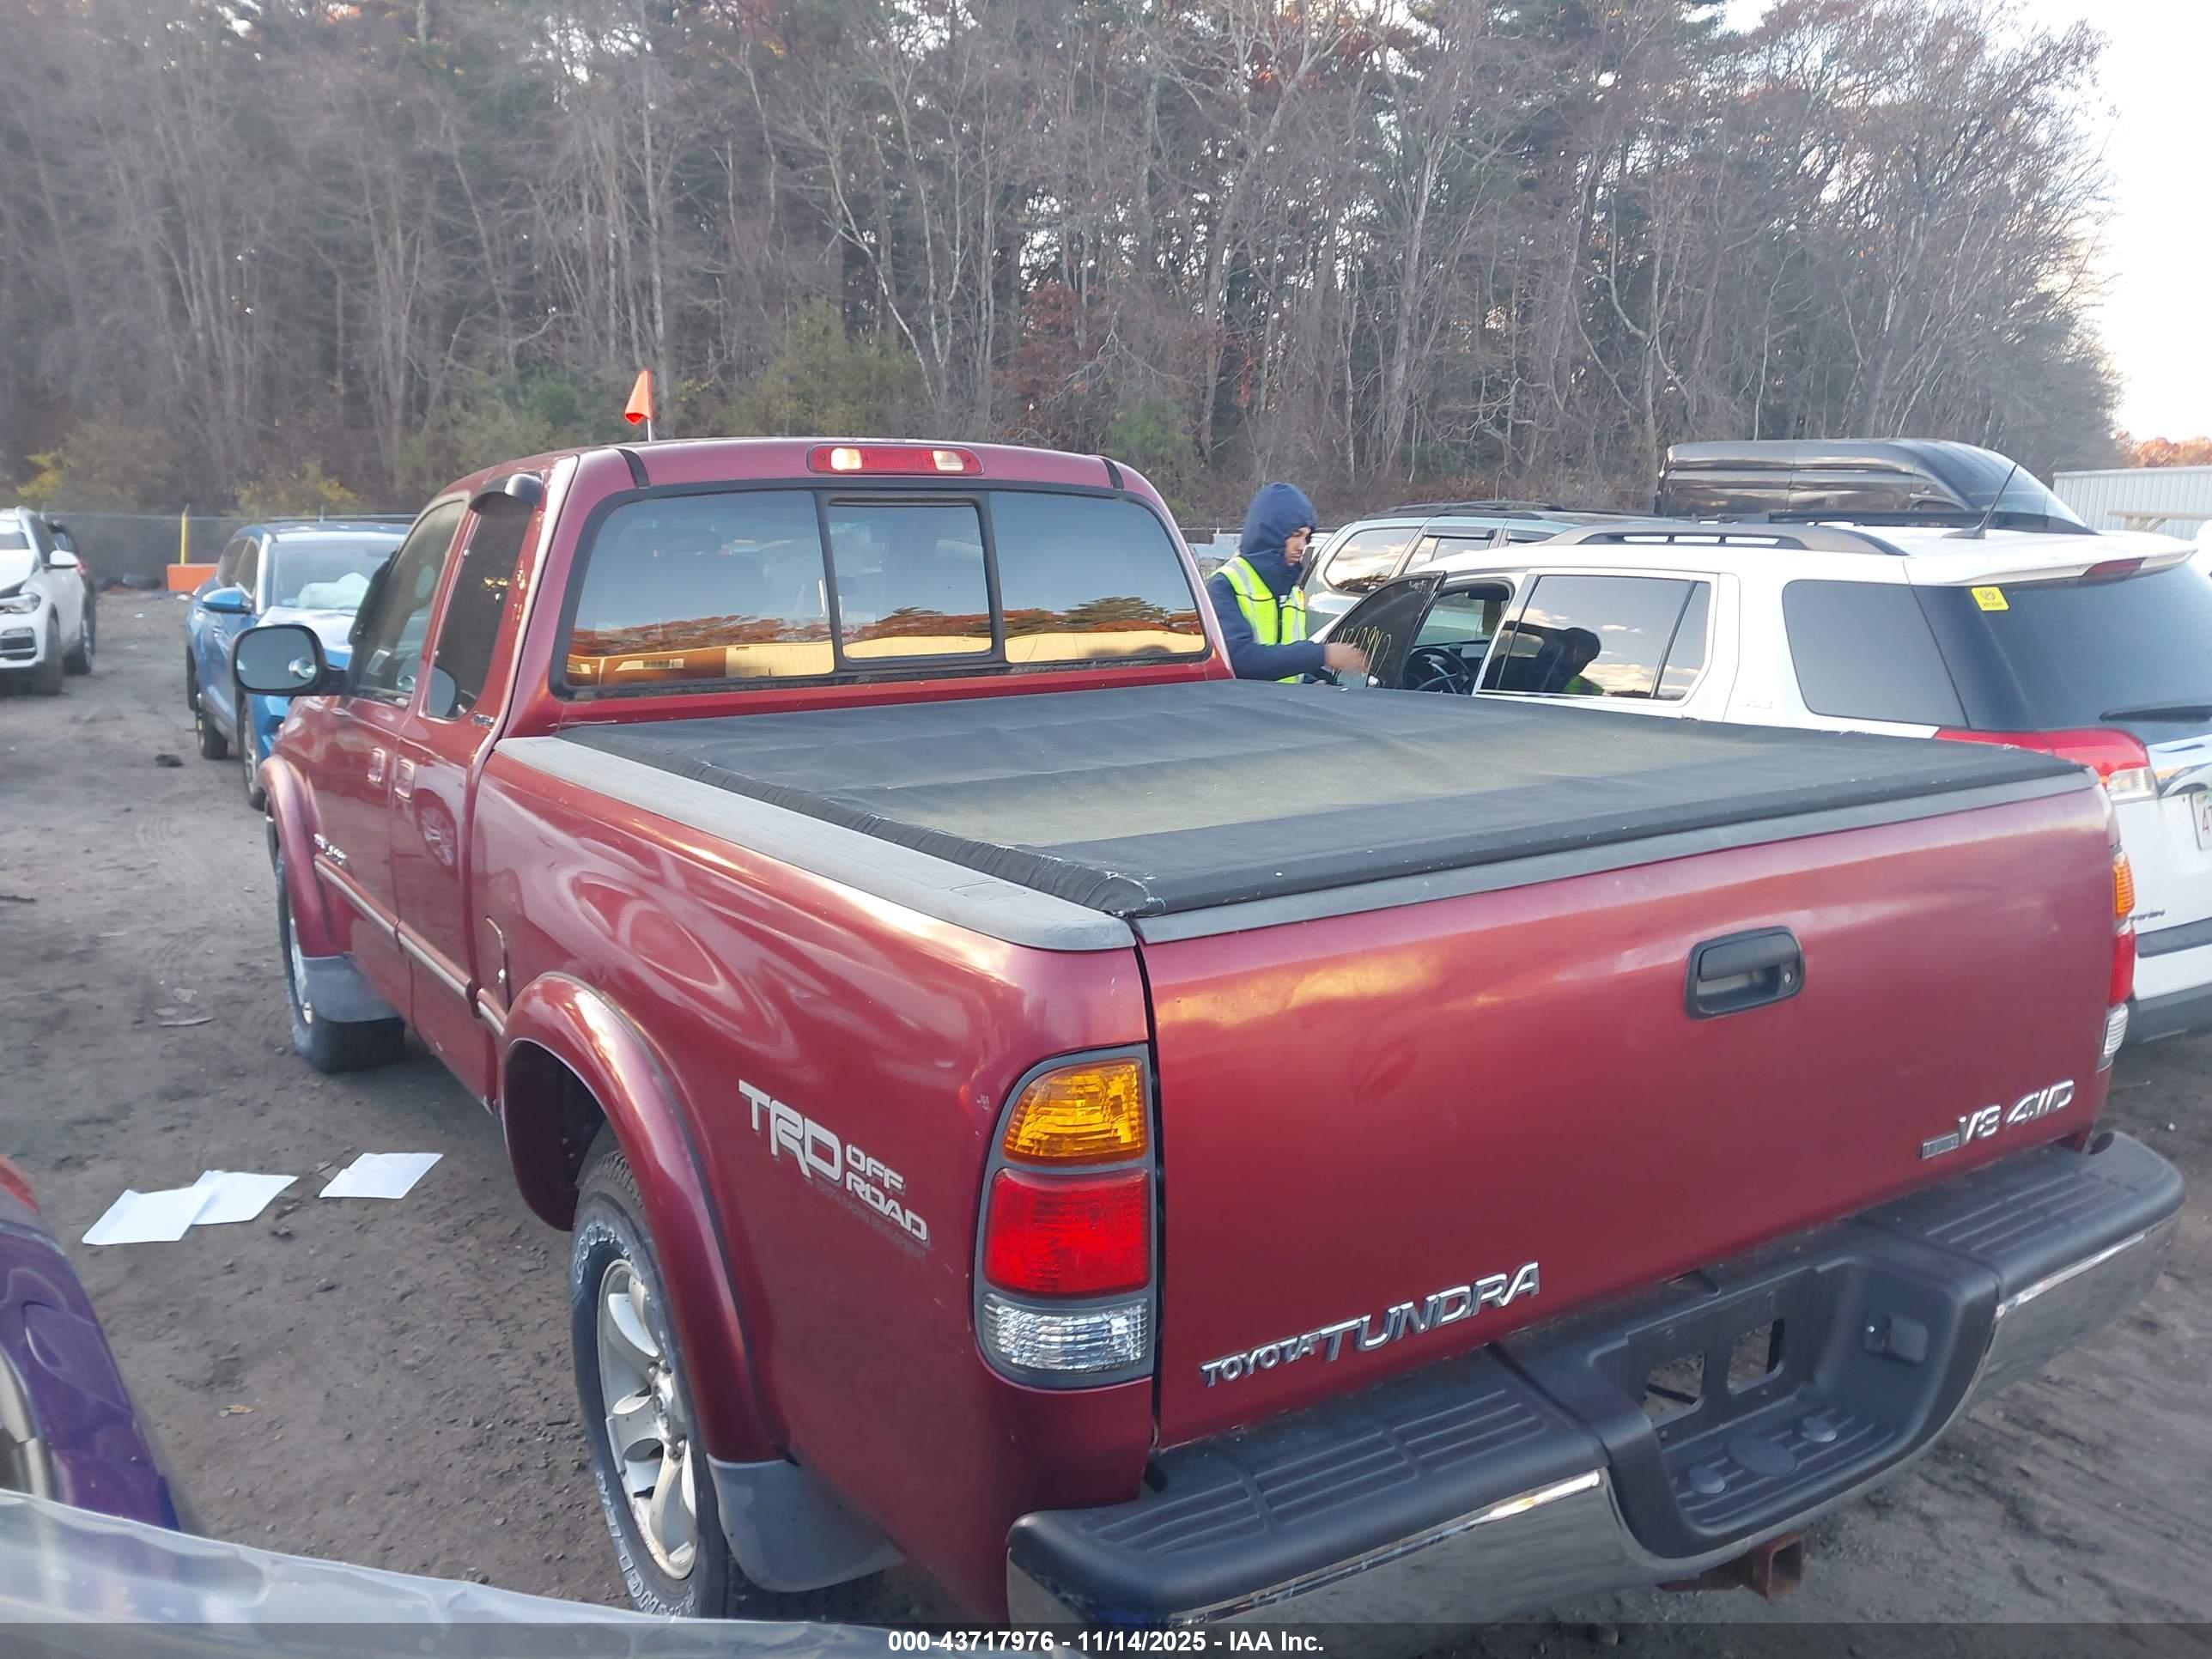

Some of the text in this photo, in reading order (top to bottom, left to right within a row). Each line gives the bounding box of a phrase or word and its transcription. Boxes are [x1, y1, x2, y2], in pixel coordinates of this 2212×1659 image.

[738, 1079, 904, 1191] TRD OFF
[1957, 1104, 2002, 1146] V8
[845, 1170, 928, 1242] ROAD
[1200, 1260, 1540, 1388] TOYOTA TUNDRA
